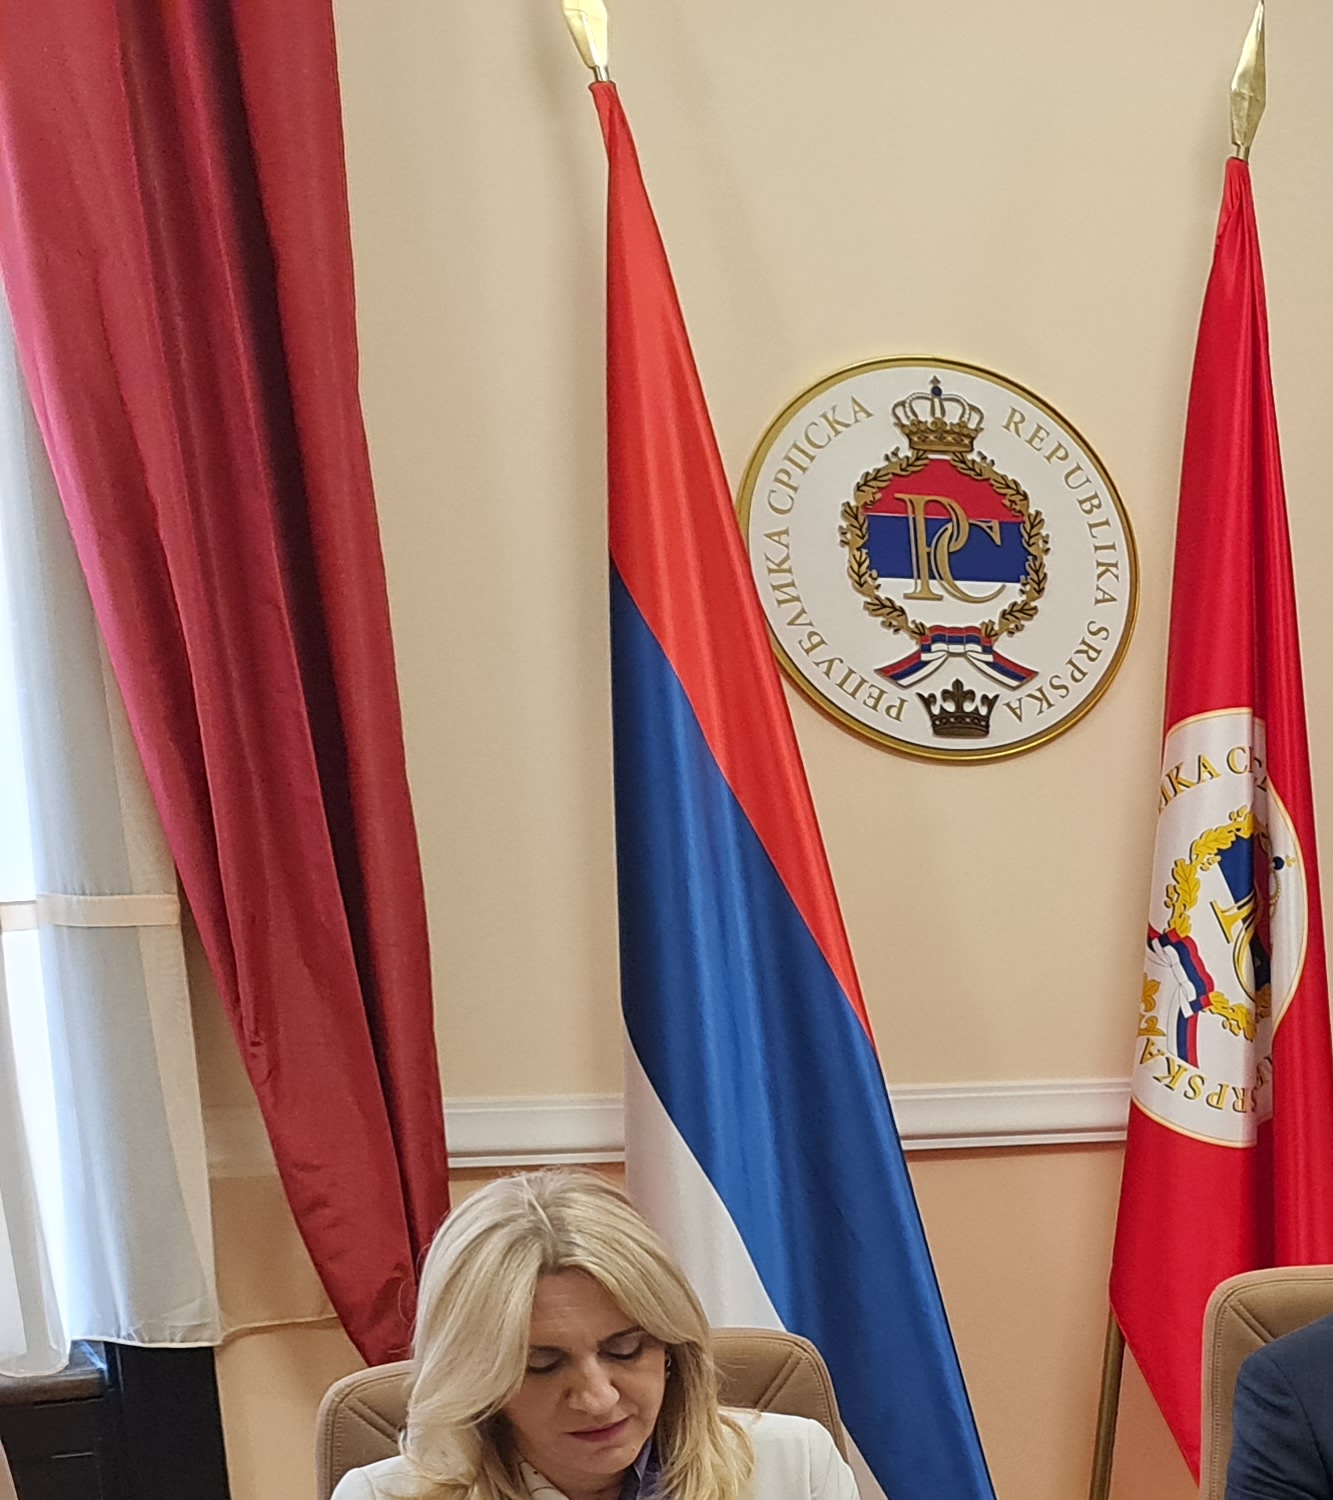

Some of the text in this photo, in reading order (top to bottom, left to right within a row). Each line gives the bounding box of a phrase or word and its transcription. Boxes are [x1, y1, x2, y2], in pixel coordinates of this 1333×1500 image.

[763, 394, 909, 723] РЕПУБЛИКА СРПСКА
[1001, 406, 1120, 724] REPUBLIKA SRPSKA
